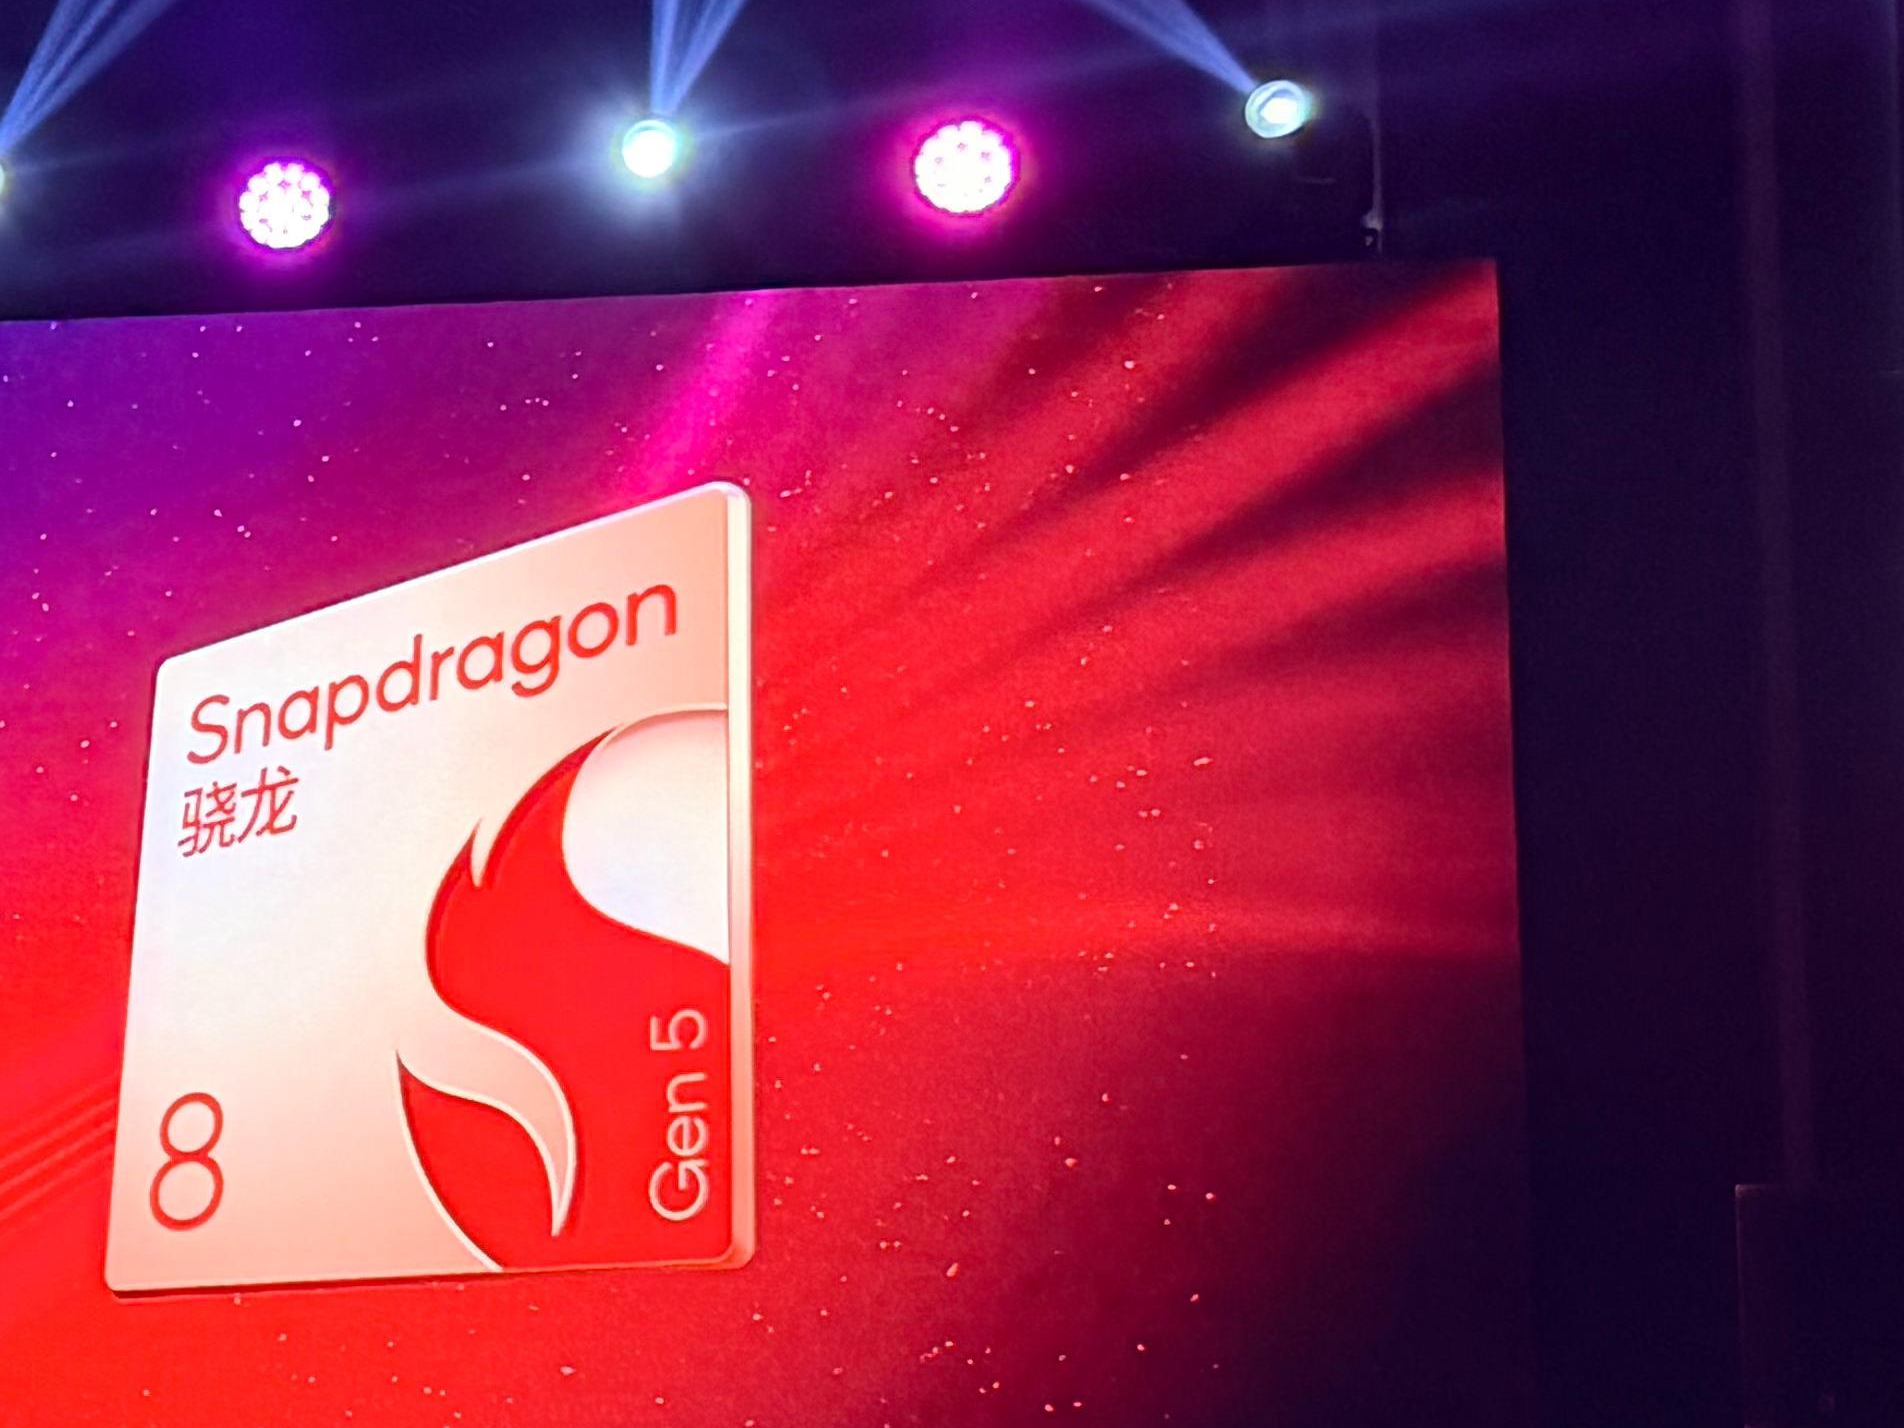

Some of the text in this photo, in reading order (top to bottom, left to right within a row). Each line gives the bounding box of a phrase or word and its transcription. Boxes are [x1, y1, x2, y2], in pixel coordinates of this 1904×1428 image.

[186, 583, 678, 765] Snapdragon
[177, 766, 300, 858] 骁龙
[149, 1092, 223, 1231] 8
[648, 1008, 710, 1222] Gen 5
